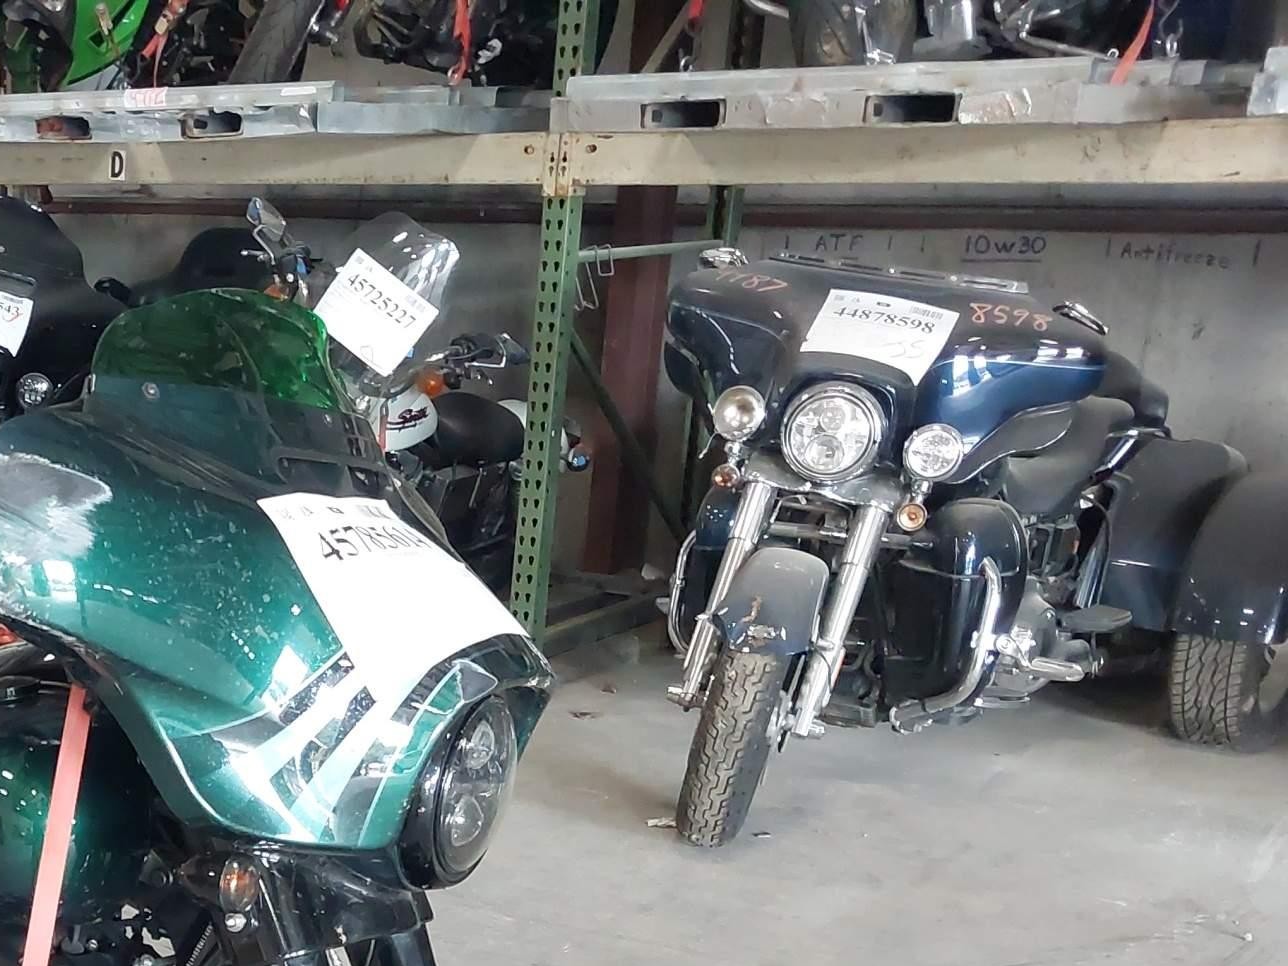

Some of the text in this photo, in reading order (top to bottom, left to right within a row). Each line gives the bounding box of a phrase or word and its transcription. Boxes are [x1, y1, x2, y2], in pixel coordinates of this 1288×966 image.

[110, 151, 124, 178] D
[815, 233, 864, 251] ATF
[348, 274, 417, 329] 45725227
[969, 301, 1053, 332] 8598
[832, 305, 936, 335] 44878598
